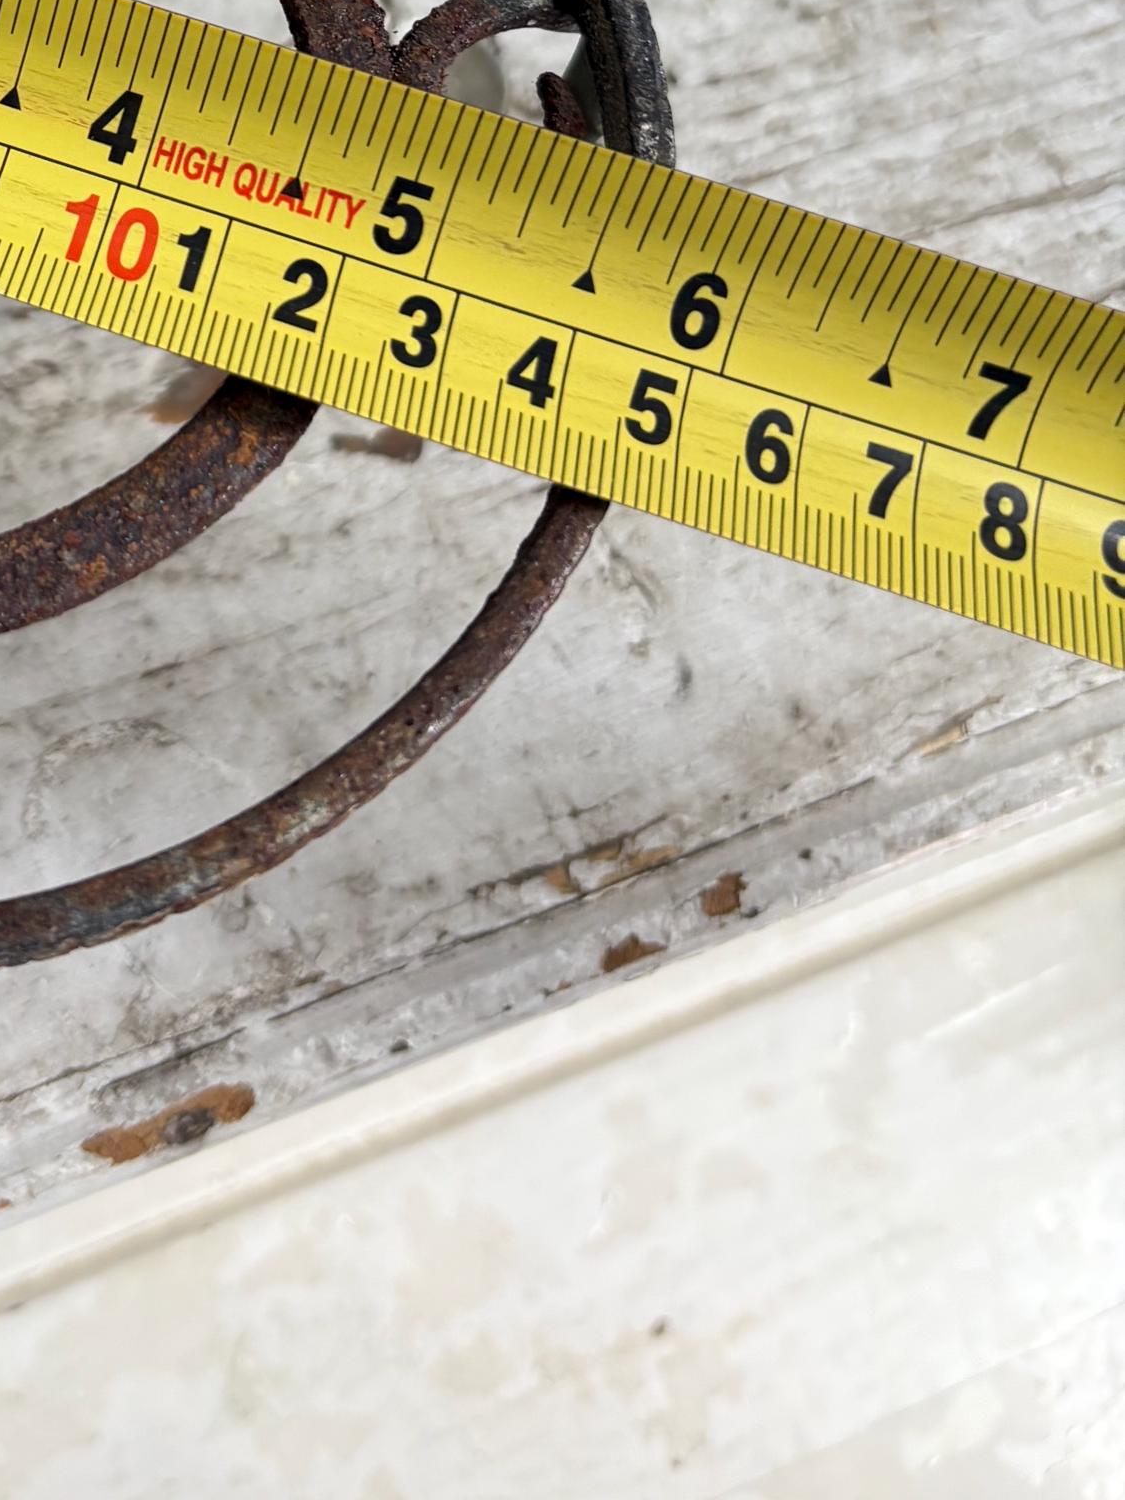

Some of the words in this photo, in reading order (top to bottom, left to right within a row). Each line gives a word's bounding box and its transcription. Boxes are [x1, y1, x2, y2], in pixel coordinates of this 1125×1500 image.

[64, 194, 160, 282] 10
[177, 226, 212, 292] 1
[273, 258, 328, 333] 2
[390, 295, 442, 369] 3
[506, 336, 559, 408] 4
[624, 368, 678, 445] 5
[745, 409, 794, 484] 6
[866, 441, 915, 519] 7
[980, 482, 1029, 561] 8
[88, 91, 143, 165] 4
[152, 137, 229, 188] HIGH
[233, 162, 366, 229] QUALITY
[372, 176, 434, 255] 5
[669, 272, 728, 351] 6
[967, 361, 1032, 440] 7
